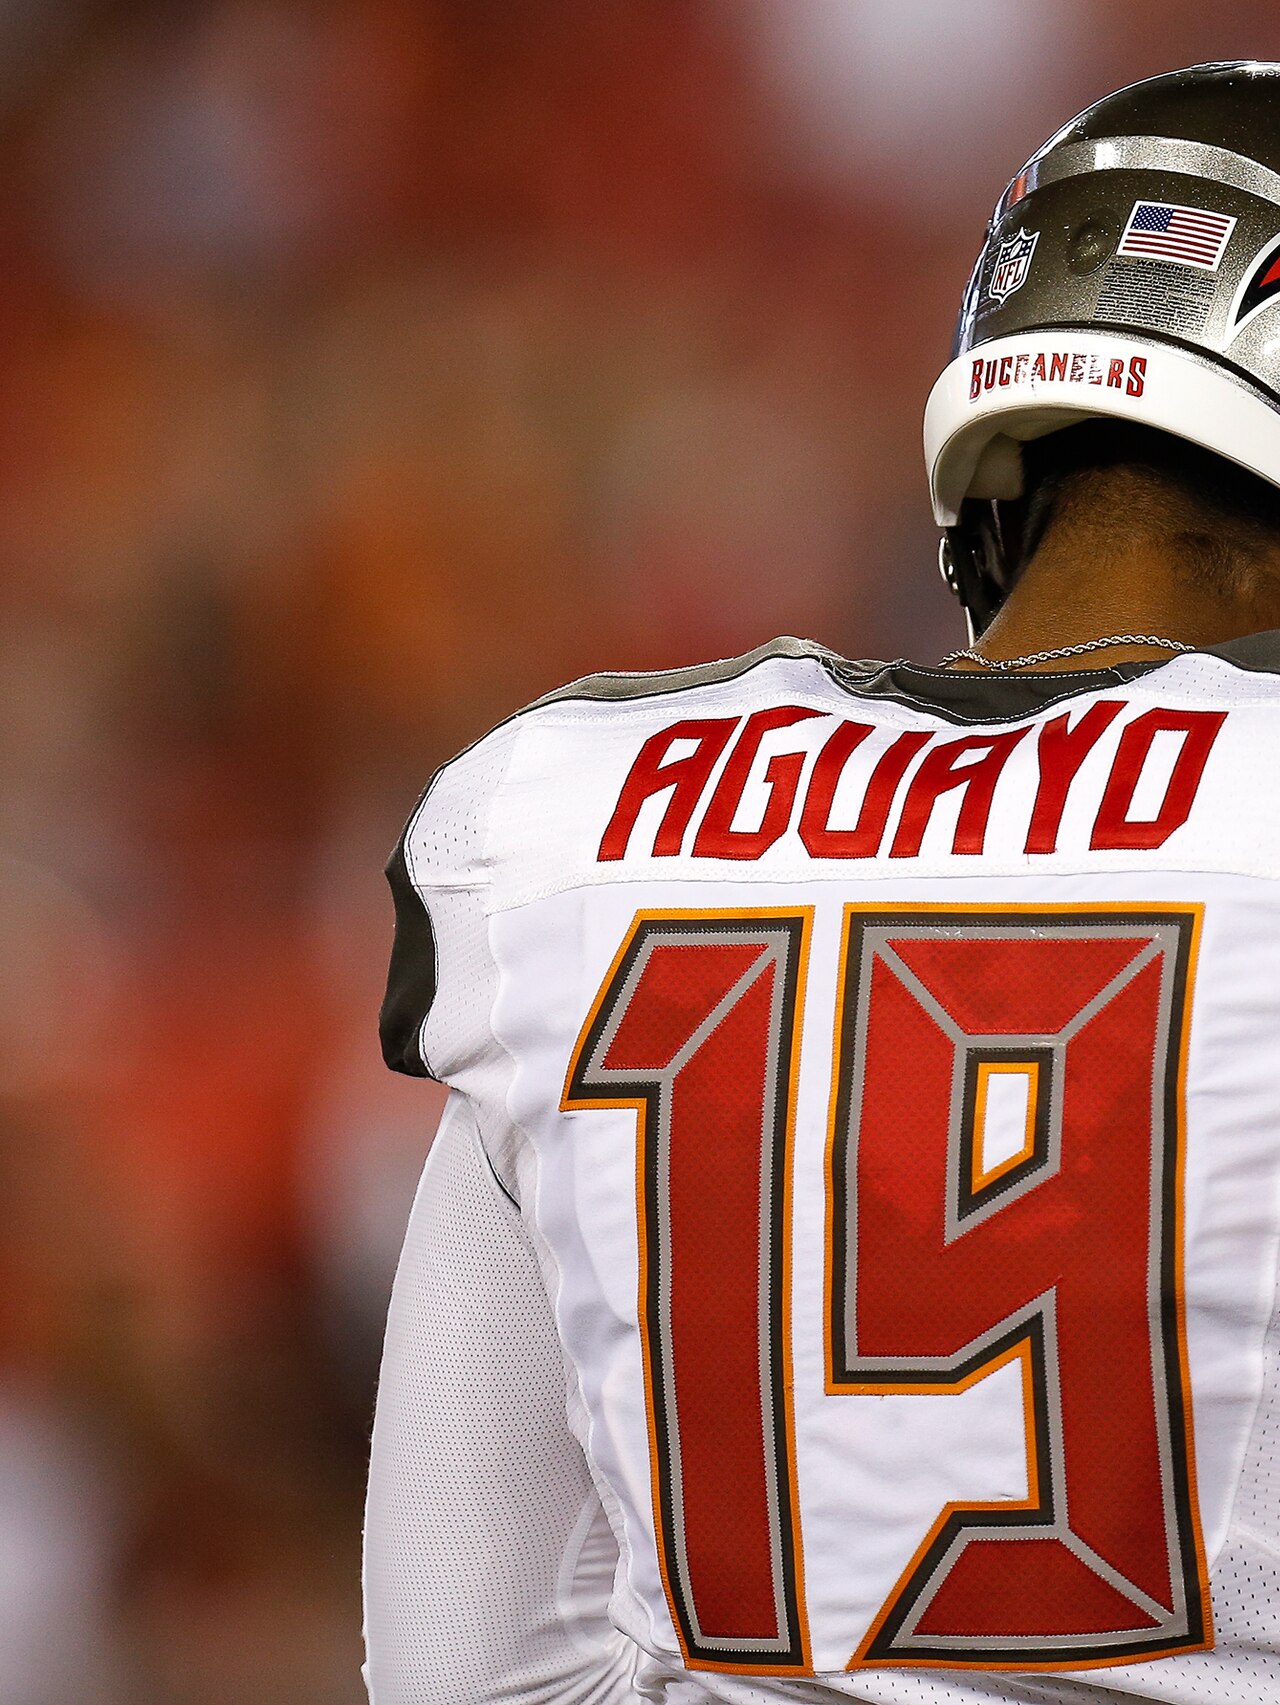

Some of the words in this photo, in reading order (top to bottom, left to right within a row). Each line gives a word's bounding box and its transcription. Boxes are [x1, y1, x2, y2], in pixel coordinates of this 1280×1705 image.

[994, 259, 1022, 290] NFL
[1137, 260, 1192, 274] WARNING
[596, 700, 1229, 861] AGUAYO
[559, 902, 1214, 1676] 19
